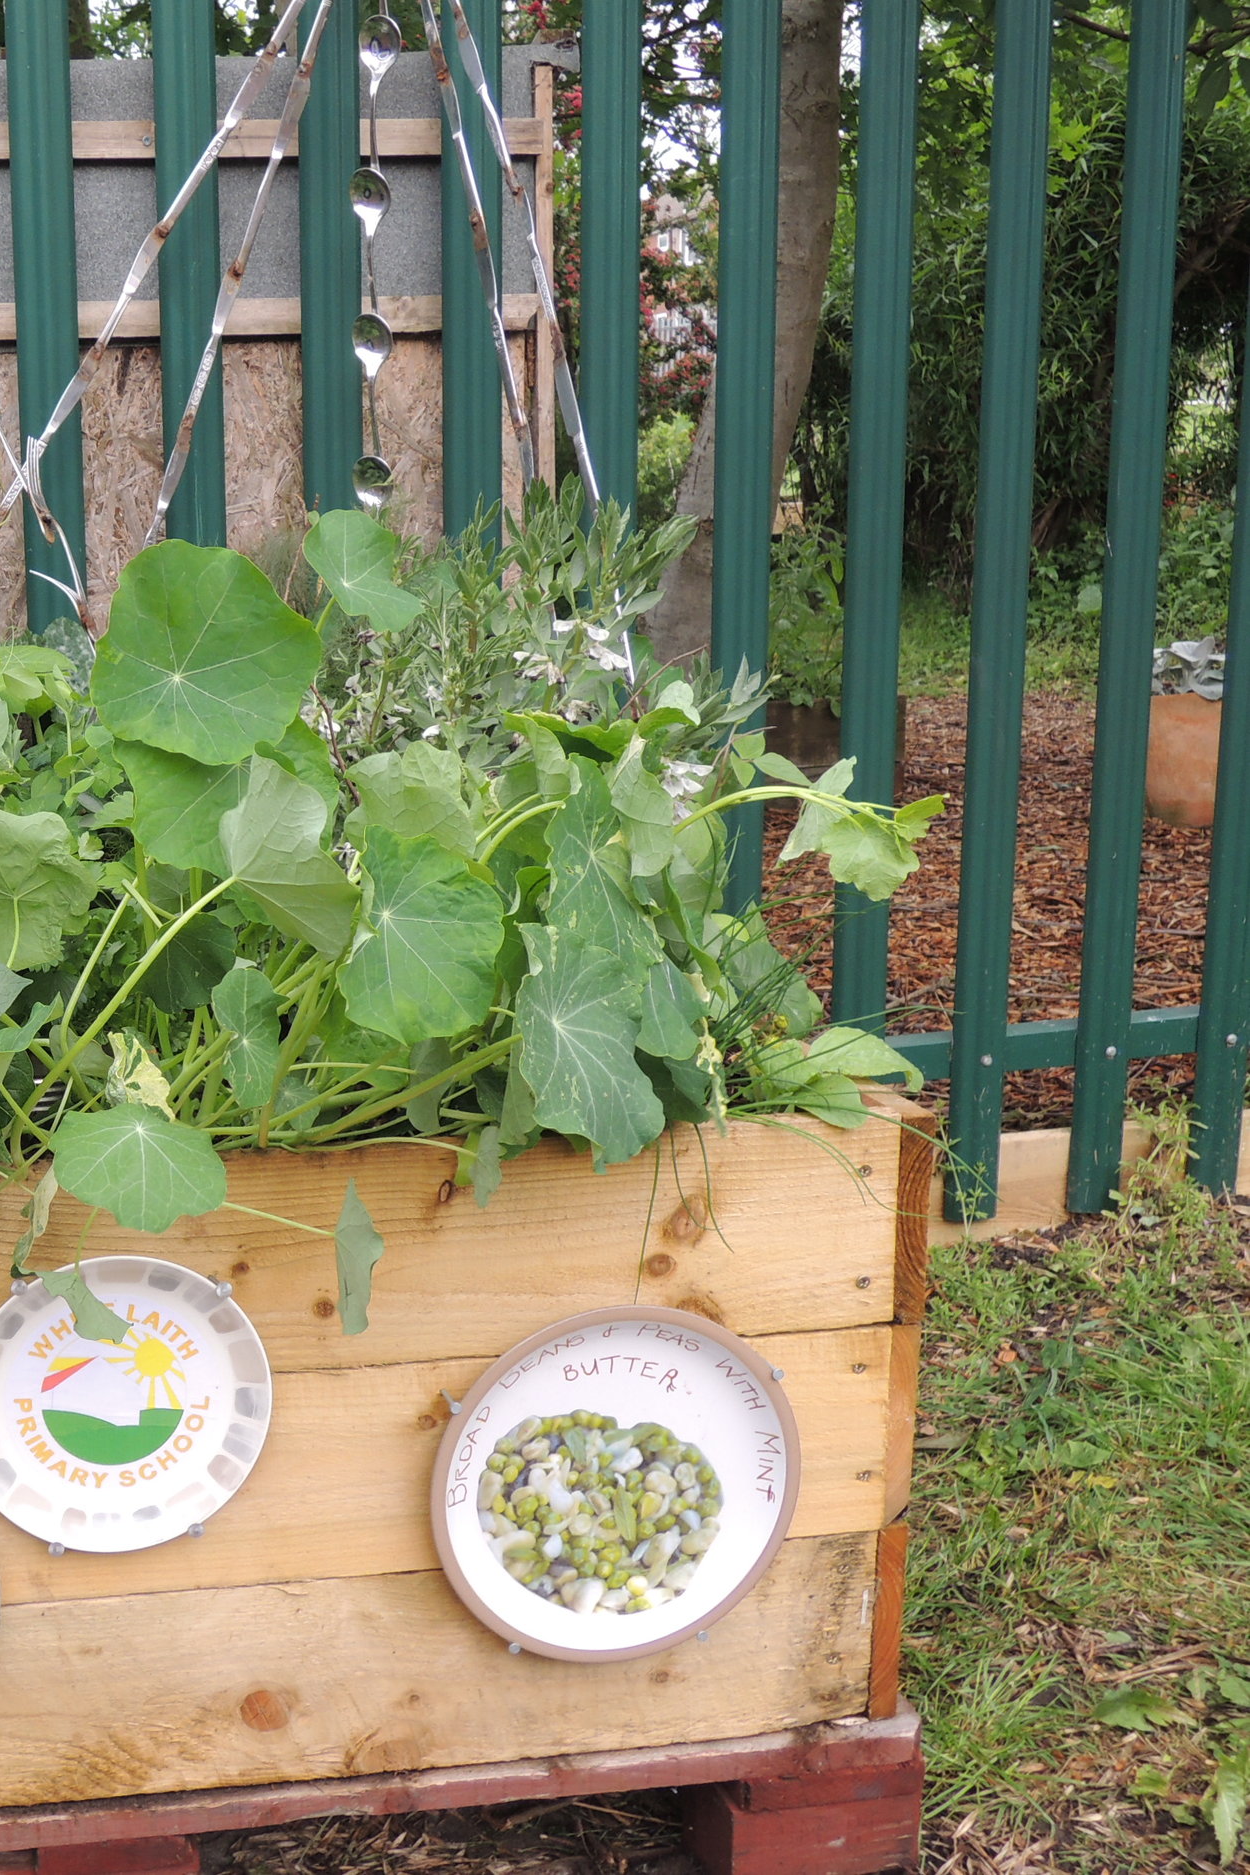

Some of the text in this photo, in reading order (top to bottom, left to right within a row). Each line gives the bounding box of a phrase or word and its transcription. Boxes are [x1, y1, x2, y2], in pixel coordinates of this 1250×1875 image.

[126, 1304, 199, 1361] LAITH
[13, 1395, 211, 1489] PRIMARY SCHOOL
[447, 1406, 491, 1508] BROAD
[637, 1323, 701, 1352] PEAS
[715, 1358, 767, 1411] WITH
[755, 1430, 782, 1504] MINT
